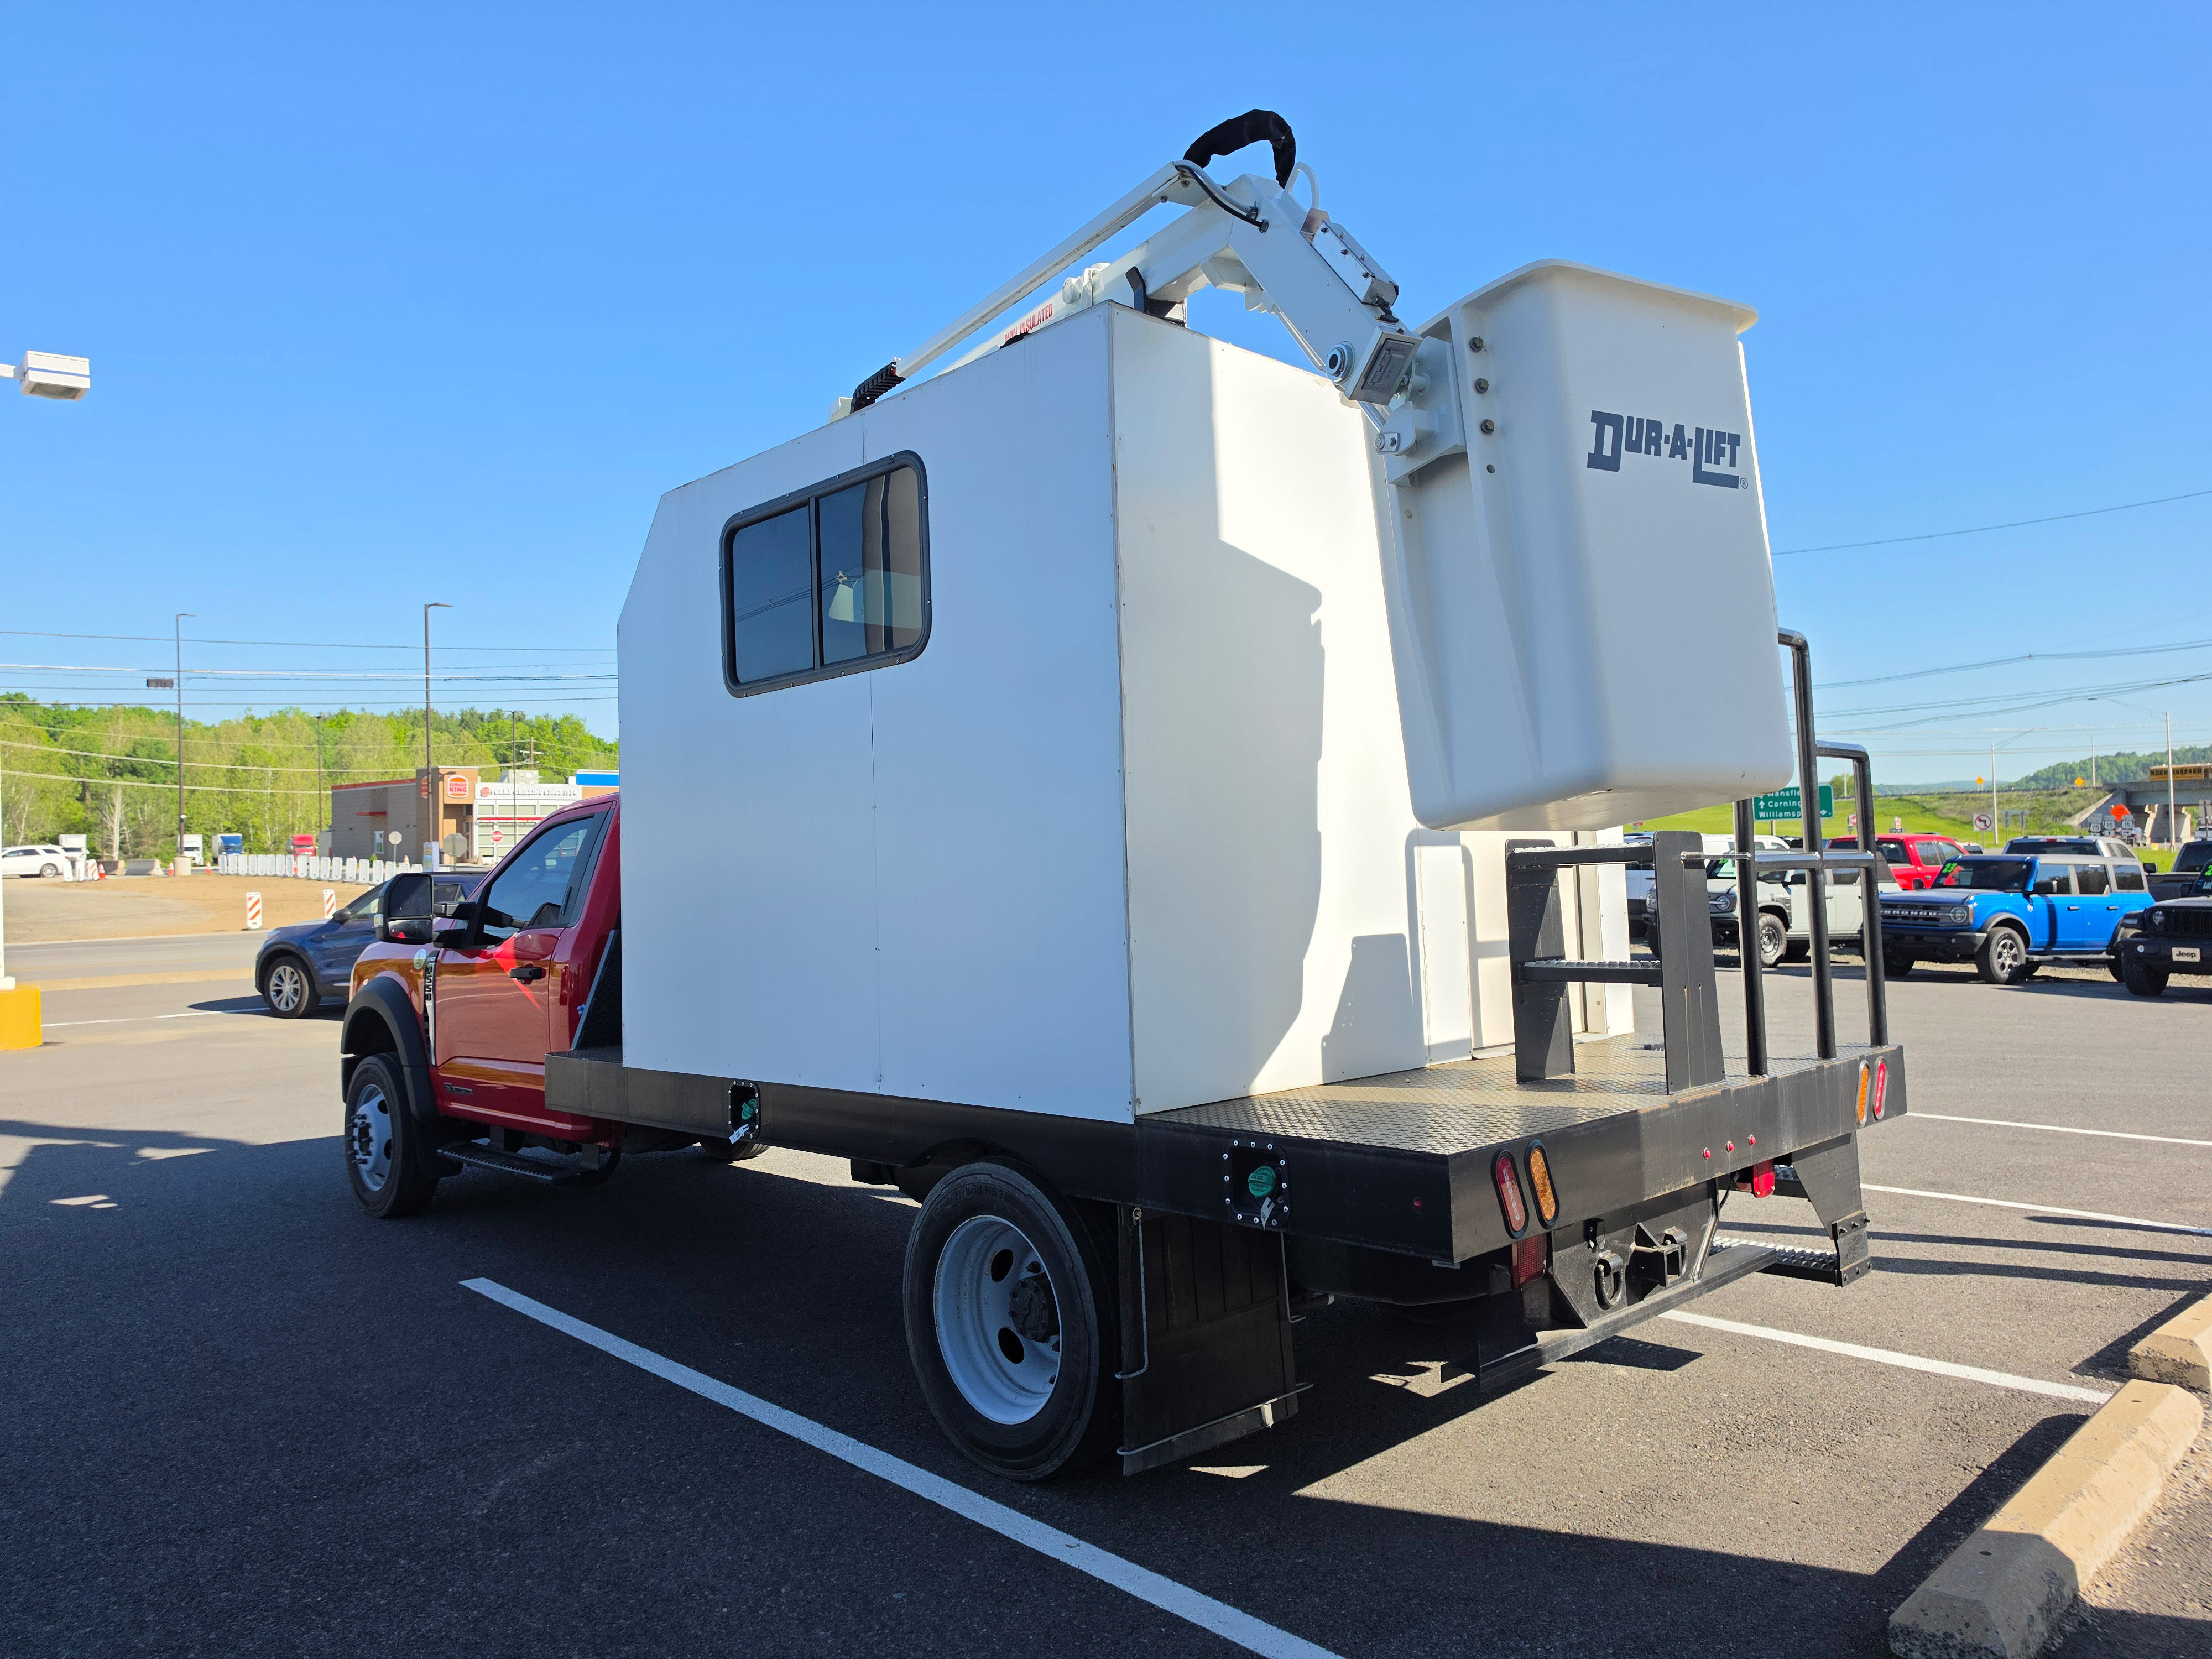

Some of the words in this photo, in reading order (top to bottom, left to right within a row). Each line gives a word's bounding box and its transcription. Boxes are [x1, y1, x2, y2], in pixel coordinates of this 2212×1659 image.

[1019, 303, 1053, 334] INSULATED
[1767, 789, 1801, 797] Mansfie
[1768, 800, 1802, 808] Corning
[2176, 951, 2197, 959] Jeep
